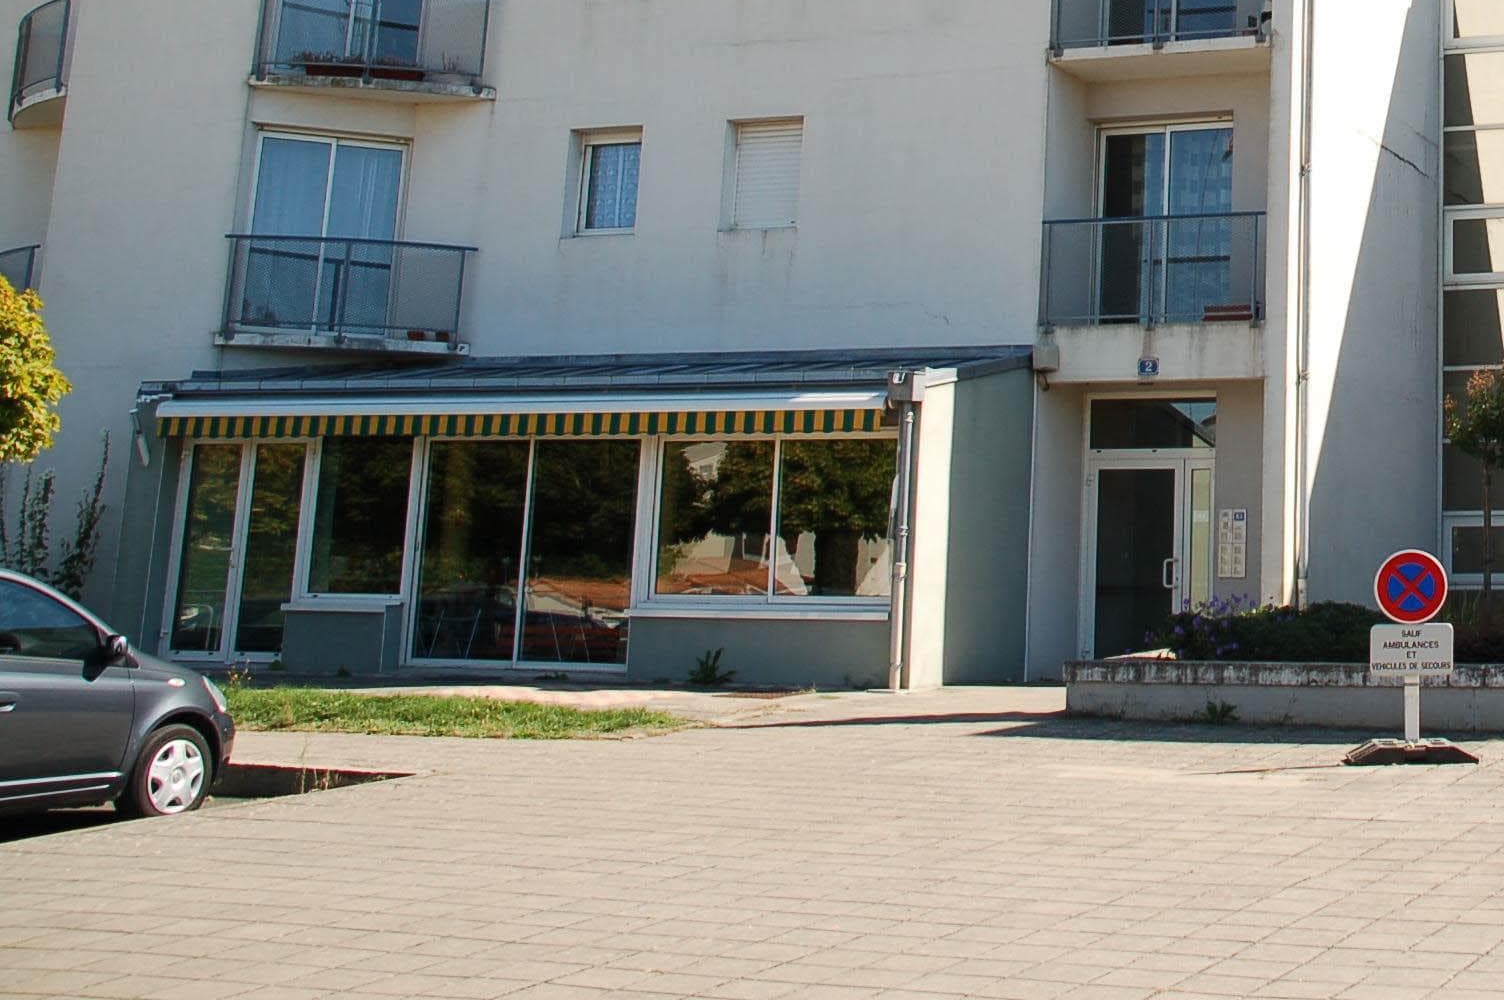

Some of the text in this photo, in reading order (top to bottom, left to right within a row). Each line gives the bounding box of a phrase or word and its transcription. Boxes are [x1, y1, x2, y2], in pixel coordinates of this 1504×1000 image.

[1145, 361, 1153, 372] 2
[1401, 629, 1422, 638] SAUF
[1382, 640, 1439, 649] AMBULANCES
[1406, 650, 1417, 659] ET
[1371, 661, 1451, 671] VEHICULES DE SECOURS
